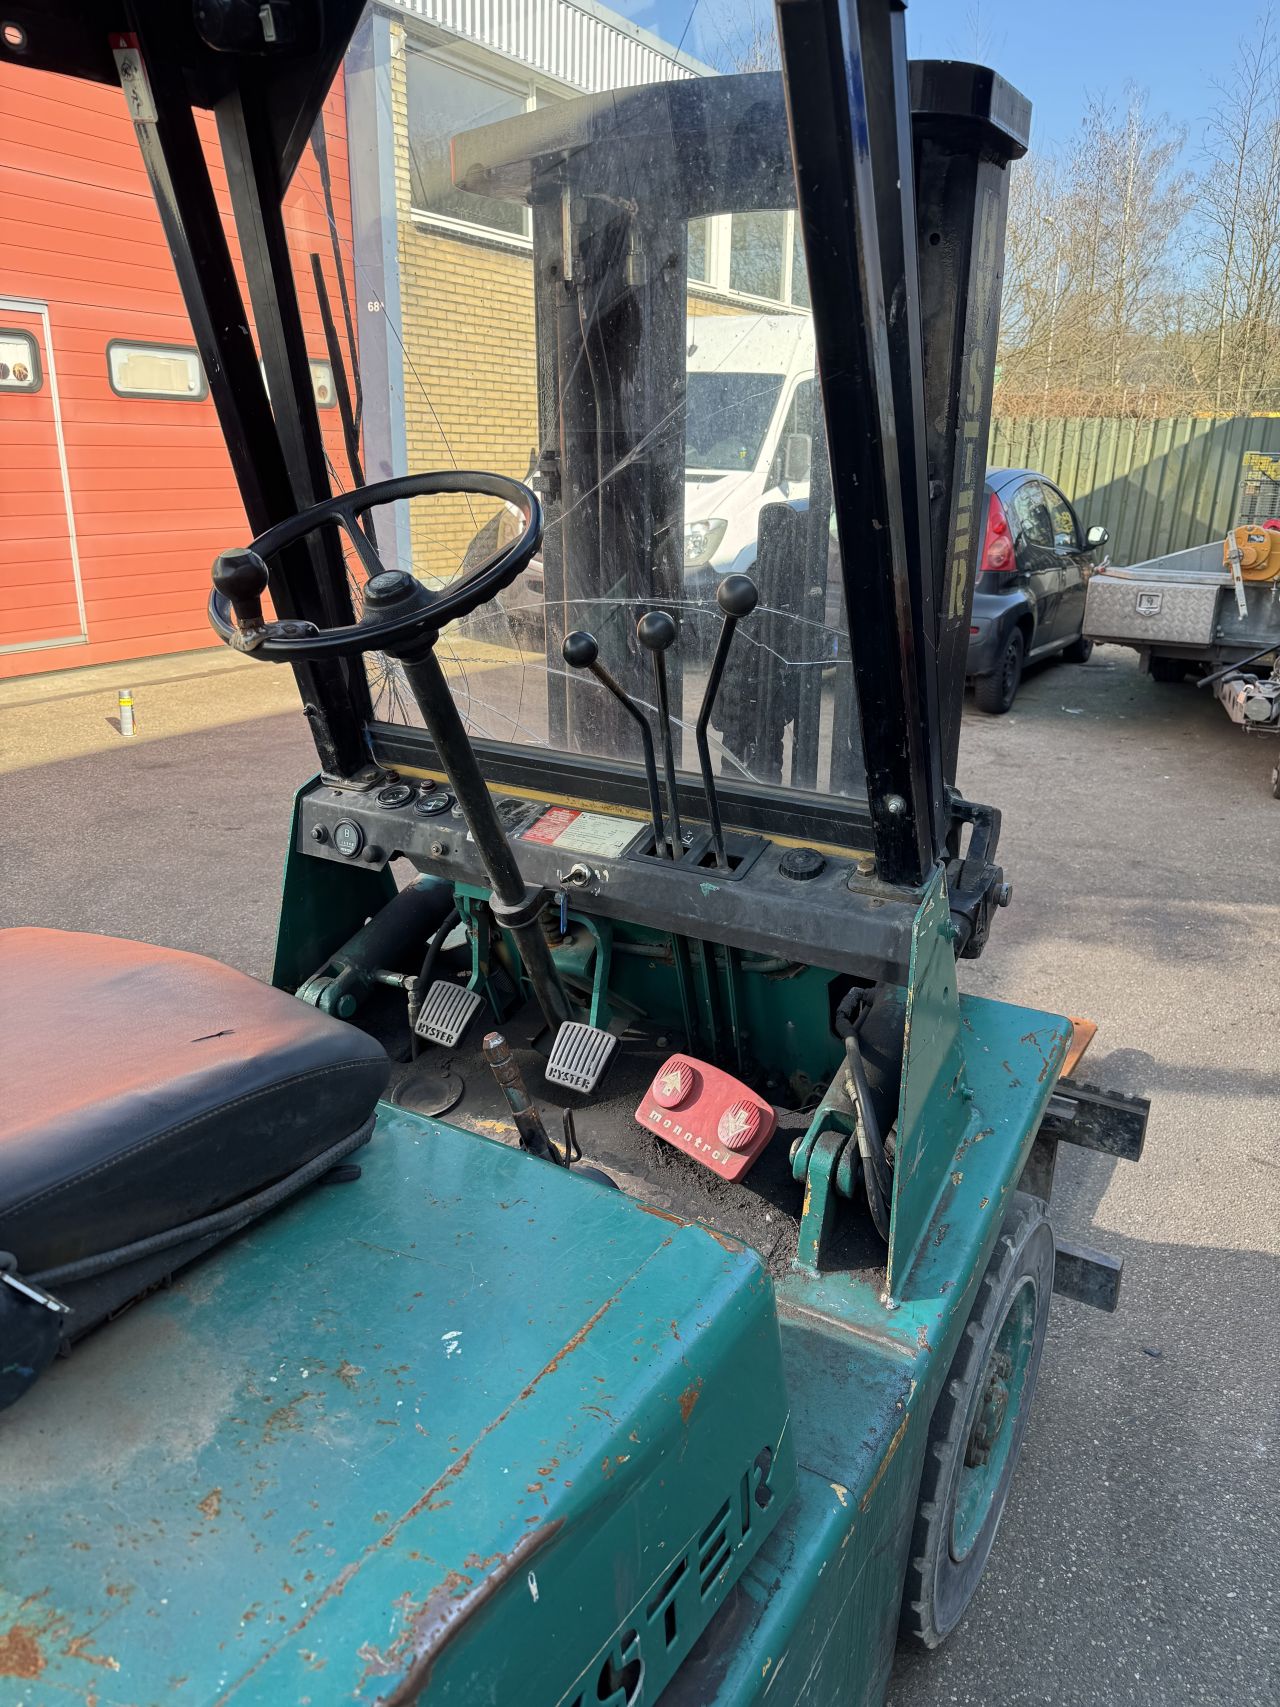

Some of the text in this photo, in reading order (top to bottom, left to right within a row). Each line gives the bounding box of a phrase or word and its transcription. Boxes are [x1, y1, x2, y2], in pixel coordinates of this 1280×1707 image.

[417, 1022, 455, 1044] HYSTER
[549, 1067, 592, 1090] HYSTER
[649, 1110, 731, 1165] monotrol
[570, 1446, 774, 1707] STER
